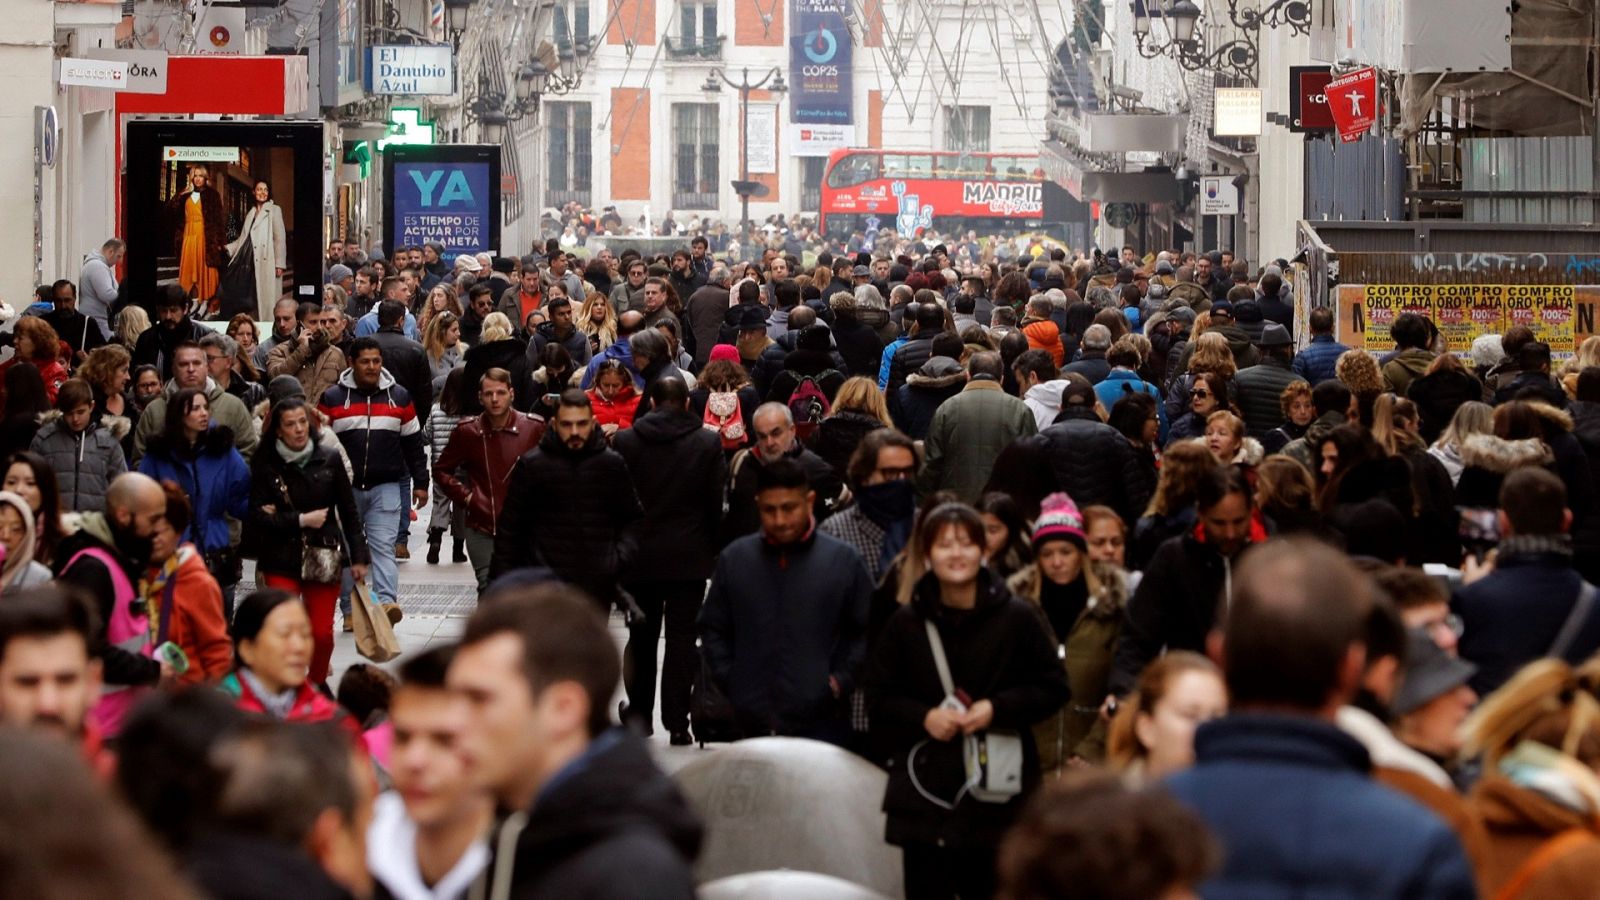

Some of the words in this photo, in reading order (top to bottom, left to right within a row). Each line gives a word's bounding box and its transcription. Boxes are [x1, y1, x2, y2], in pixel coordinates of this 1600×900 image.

[380, 48, 397, 62] El
[67, 67, 113, 81] swatch
[380, 64, 446, 78] Danubio
[802, 65, 838, 76] COP25
[1327, 74, 1359, 89] PROTEGIDO
[1359, 70, 1372, 80] POR
[380, 79, 418, 92] Azul
[178, 149, 210, 157] zalando
[408, 170, 475, 207] YA
[404, 217, 417, 226] ES
[420, 216, 462, 226] TIEMPO
[464, 217, 479, 226] DE
[404, 226, 452, 236] ACTUAR
[455, 226, 479, 236] POR
[403, 236, 418, 246] EL
[1367, 286, 1432, 296] COMPRO
[1437, 286, 1503, 296] COMPRO
[1508, 286, 1573, 296] COMPRO
